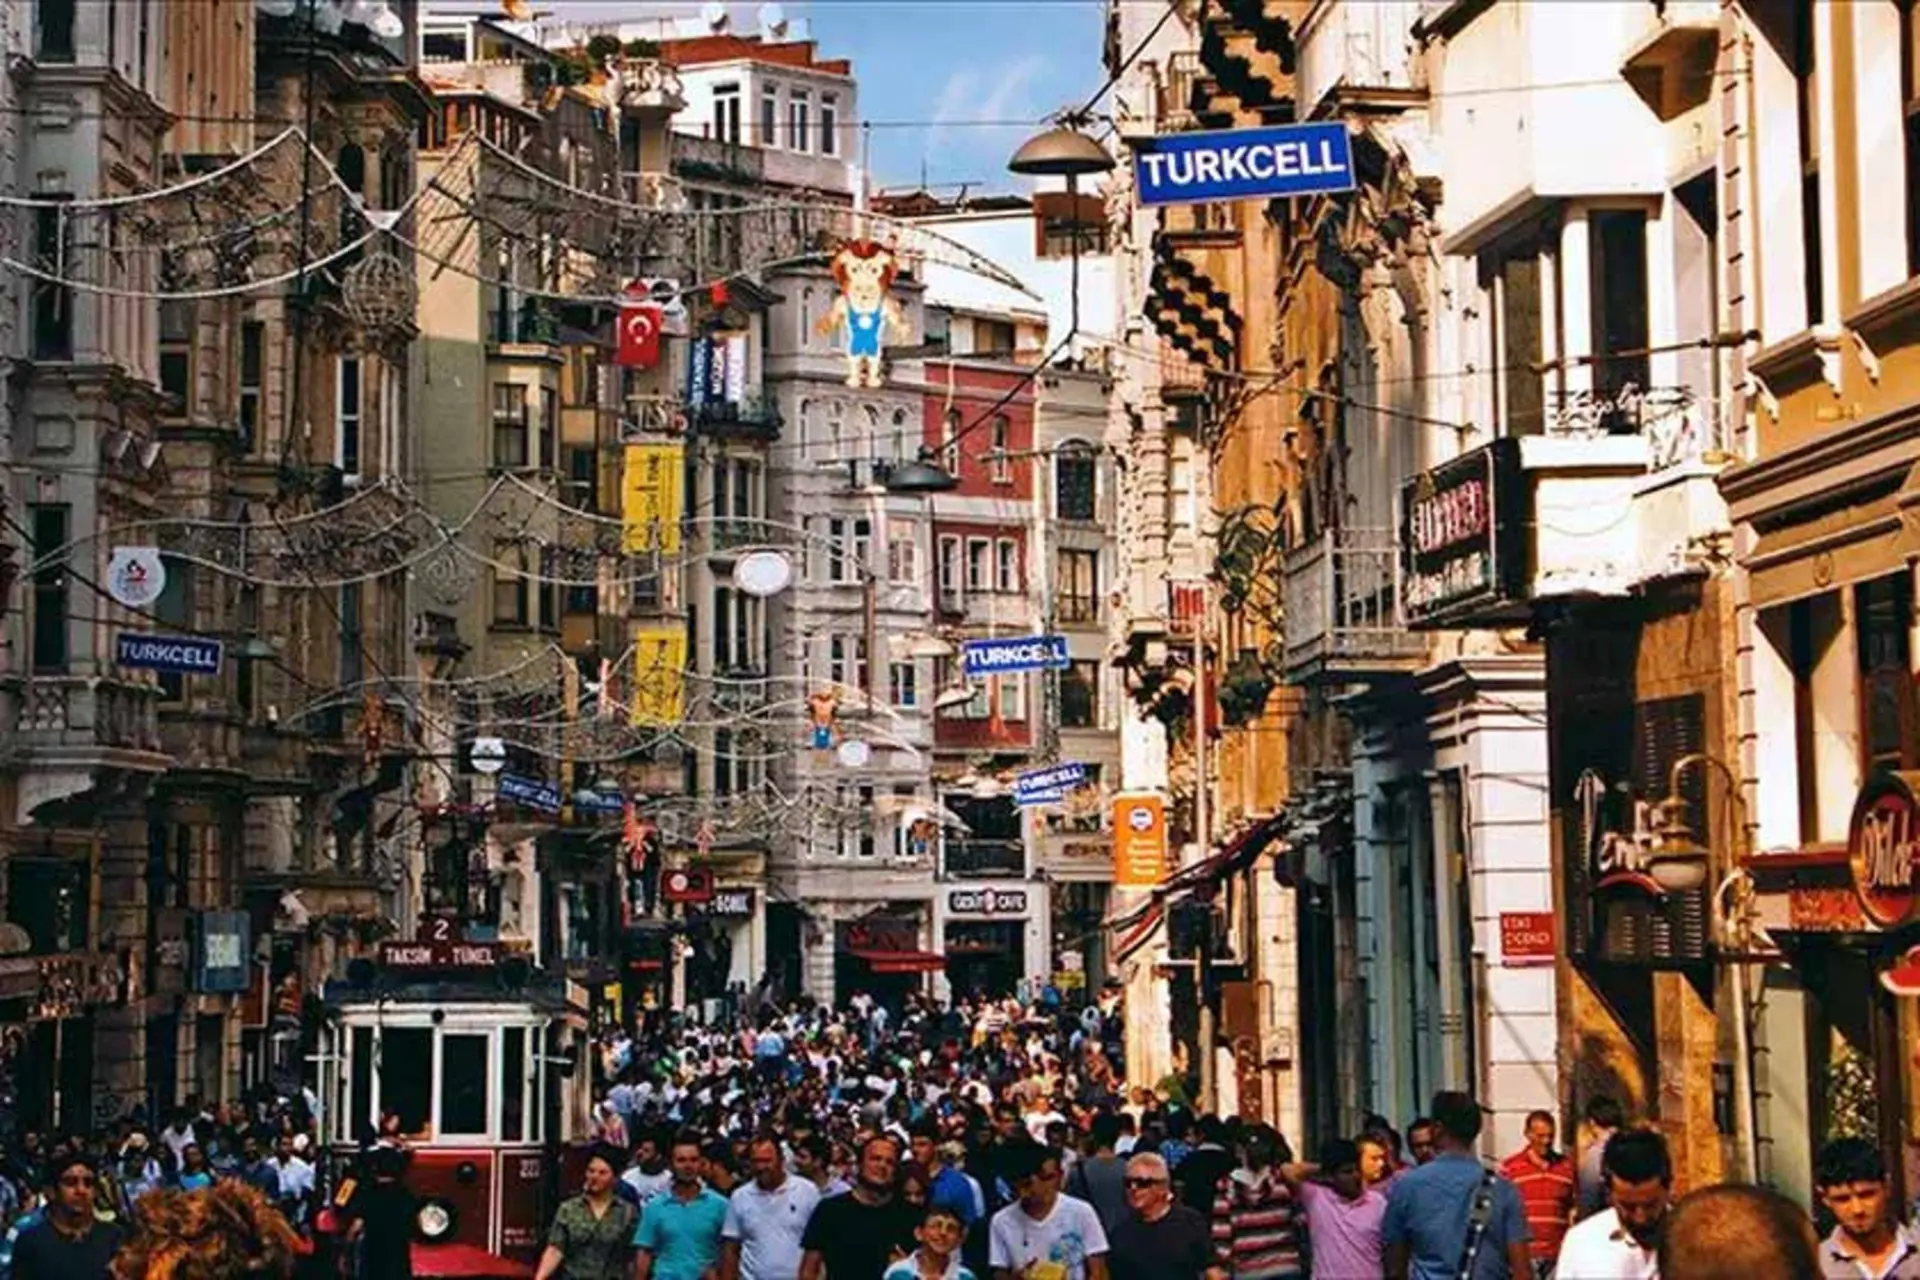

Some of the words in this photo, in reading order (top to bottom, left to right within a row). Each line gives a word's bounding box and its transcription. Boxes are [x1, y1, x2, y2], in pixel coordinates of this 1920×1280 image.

[1141, 139, 1347, 187] TURKCELL
[119, 641, 217, 667] TURKCELL
[433, 918, 450, 940] 2
